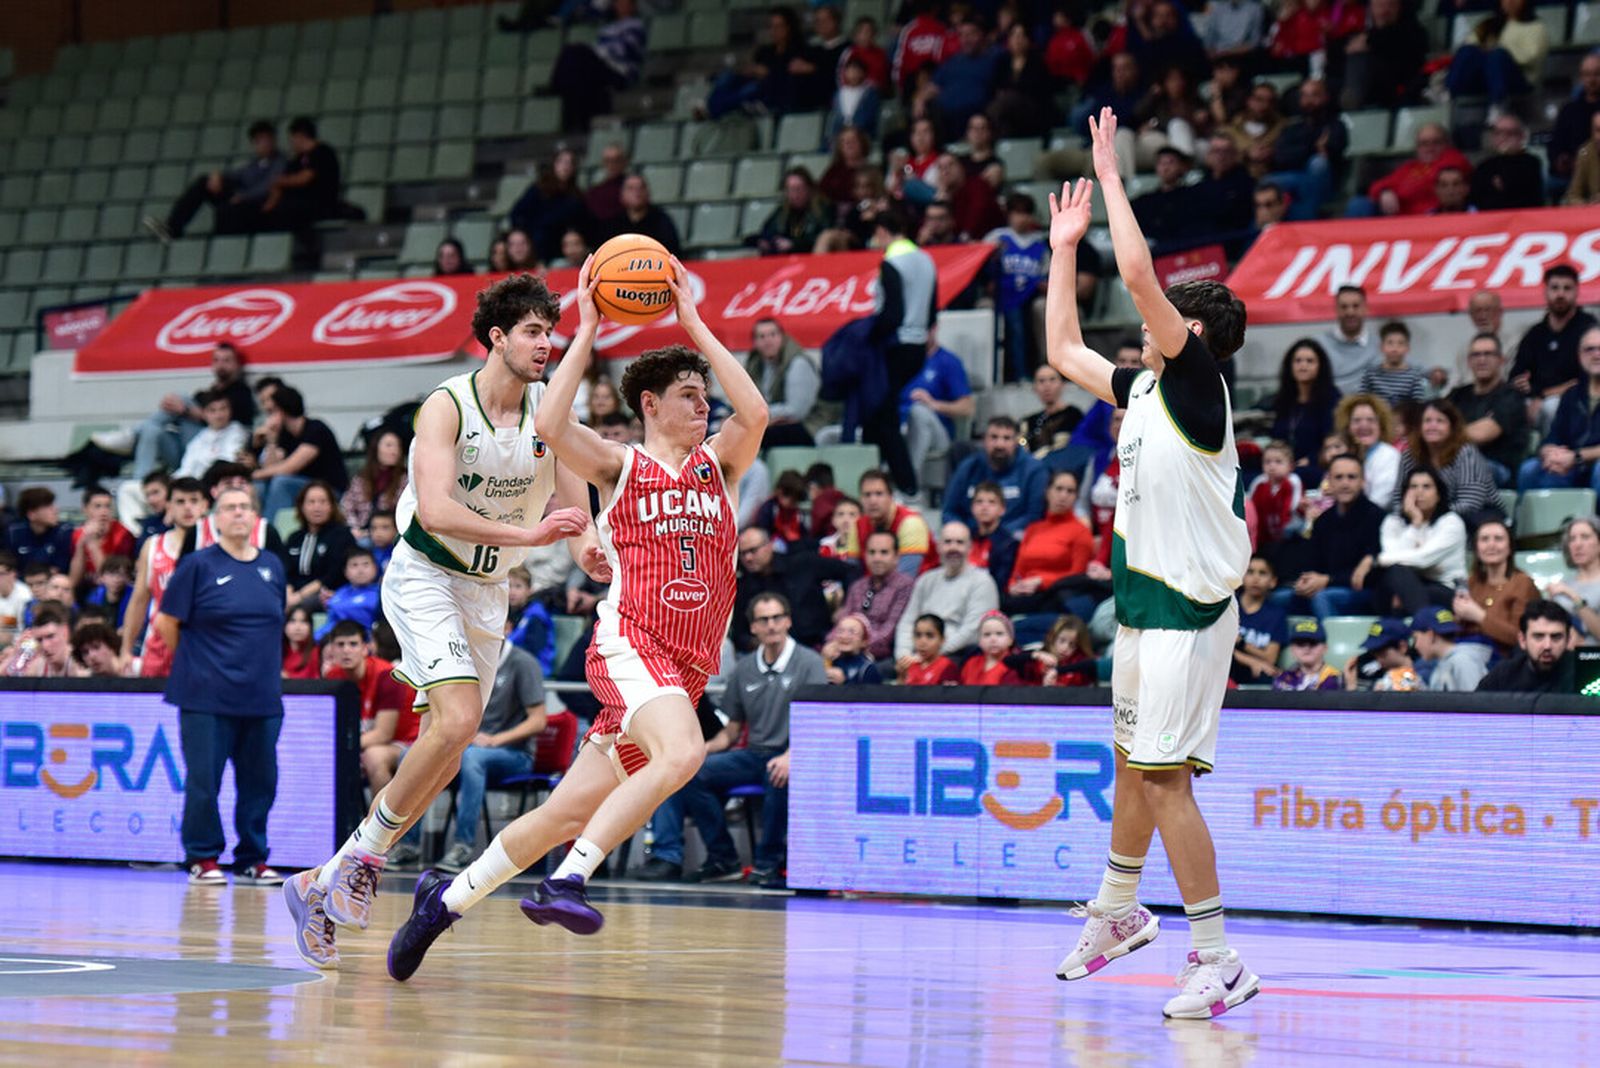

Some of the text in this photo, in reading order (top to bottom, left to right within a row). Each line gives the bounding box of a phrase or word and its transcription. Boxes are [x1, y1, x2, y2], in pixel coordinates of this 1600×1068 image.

[615, 287, 673, 307] Wilson
[172, 313, 272, 338] Juver
[328, 305, 436, 331] Juver
[637, 489, 723, 523] UCAM
[655, 517, 715, 537] MURCIA
[467, 544, 500, 574] 16
[680, 536, 697, 573] 5
[665, 588, 706, 602] Juver
[1252, 783, 1600, 843] Fibra óptica T
